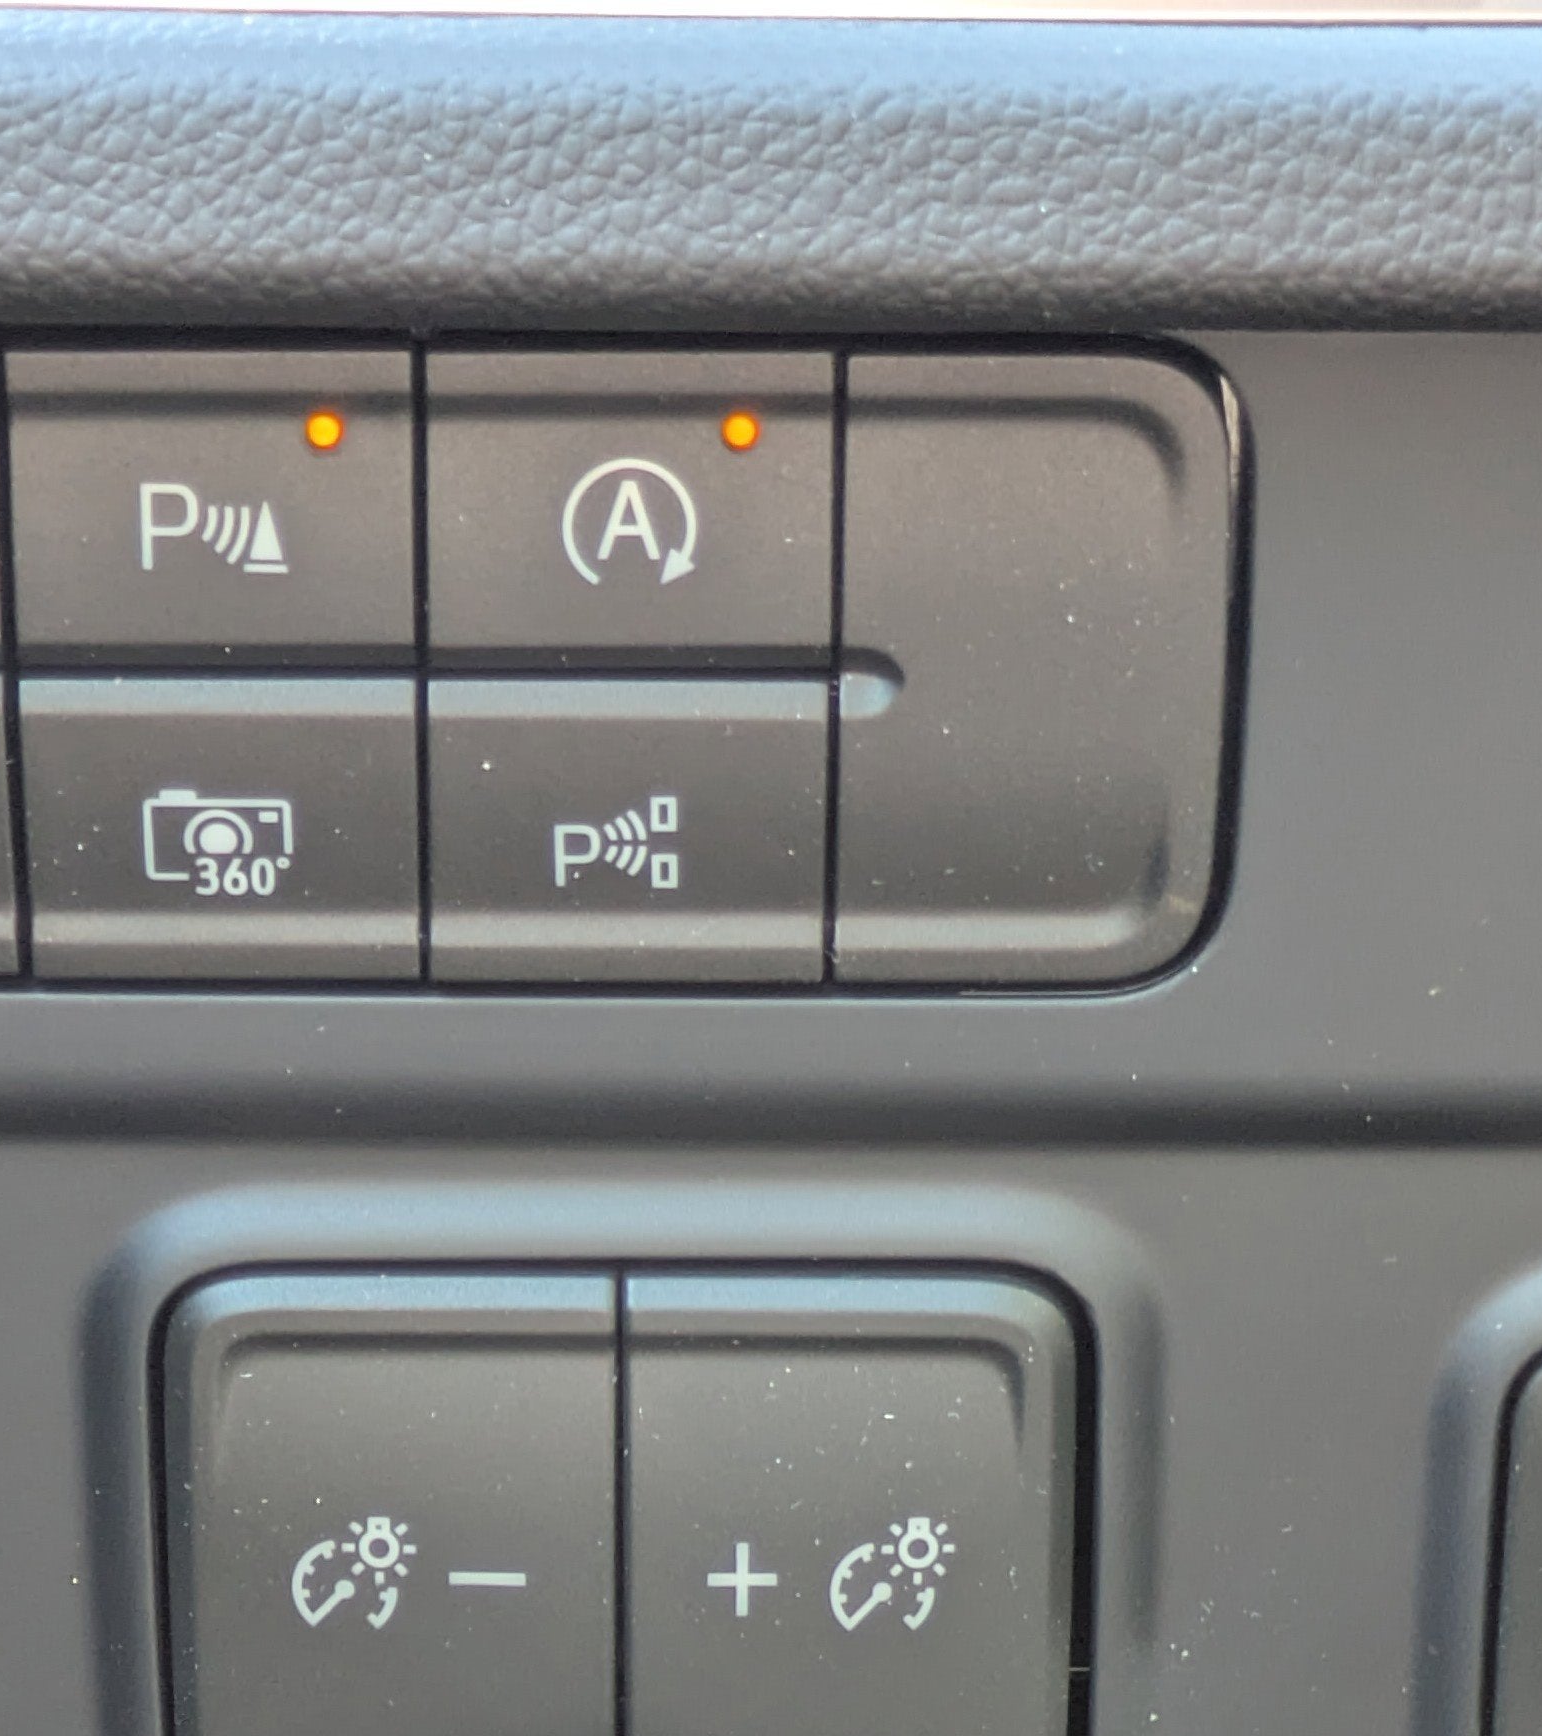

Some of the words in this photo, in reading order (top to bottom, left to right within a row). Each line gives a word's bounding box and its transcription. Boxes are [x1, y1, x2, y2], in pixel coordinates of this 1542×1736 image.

[140, 483, 198, 569] P
[596, 481, 661, 560] A
[554, 823, 599, 886] P
